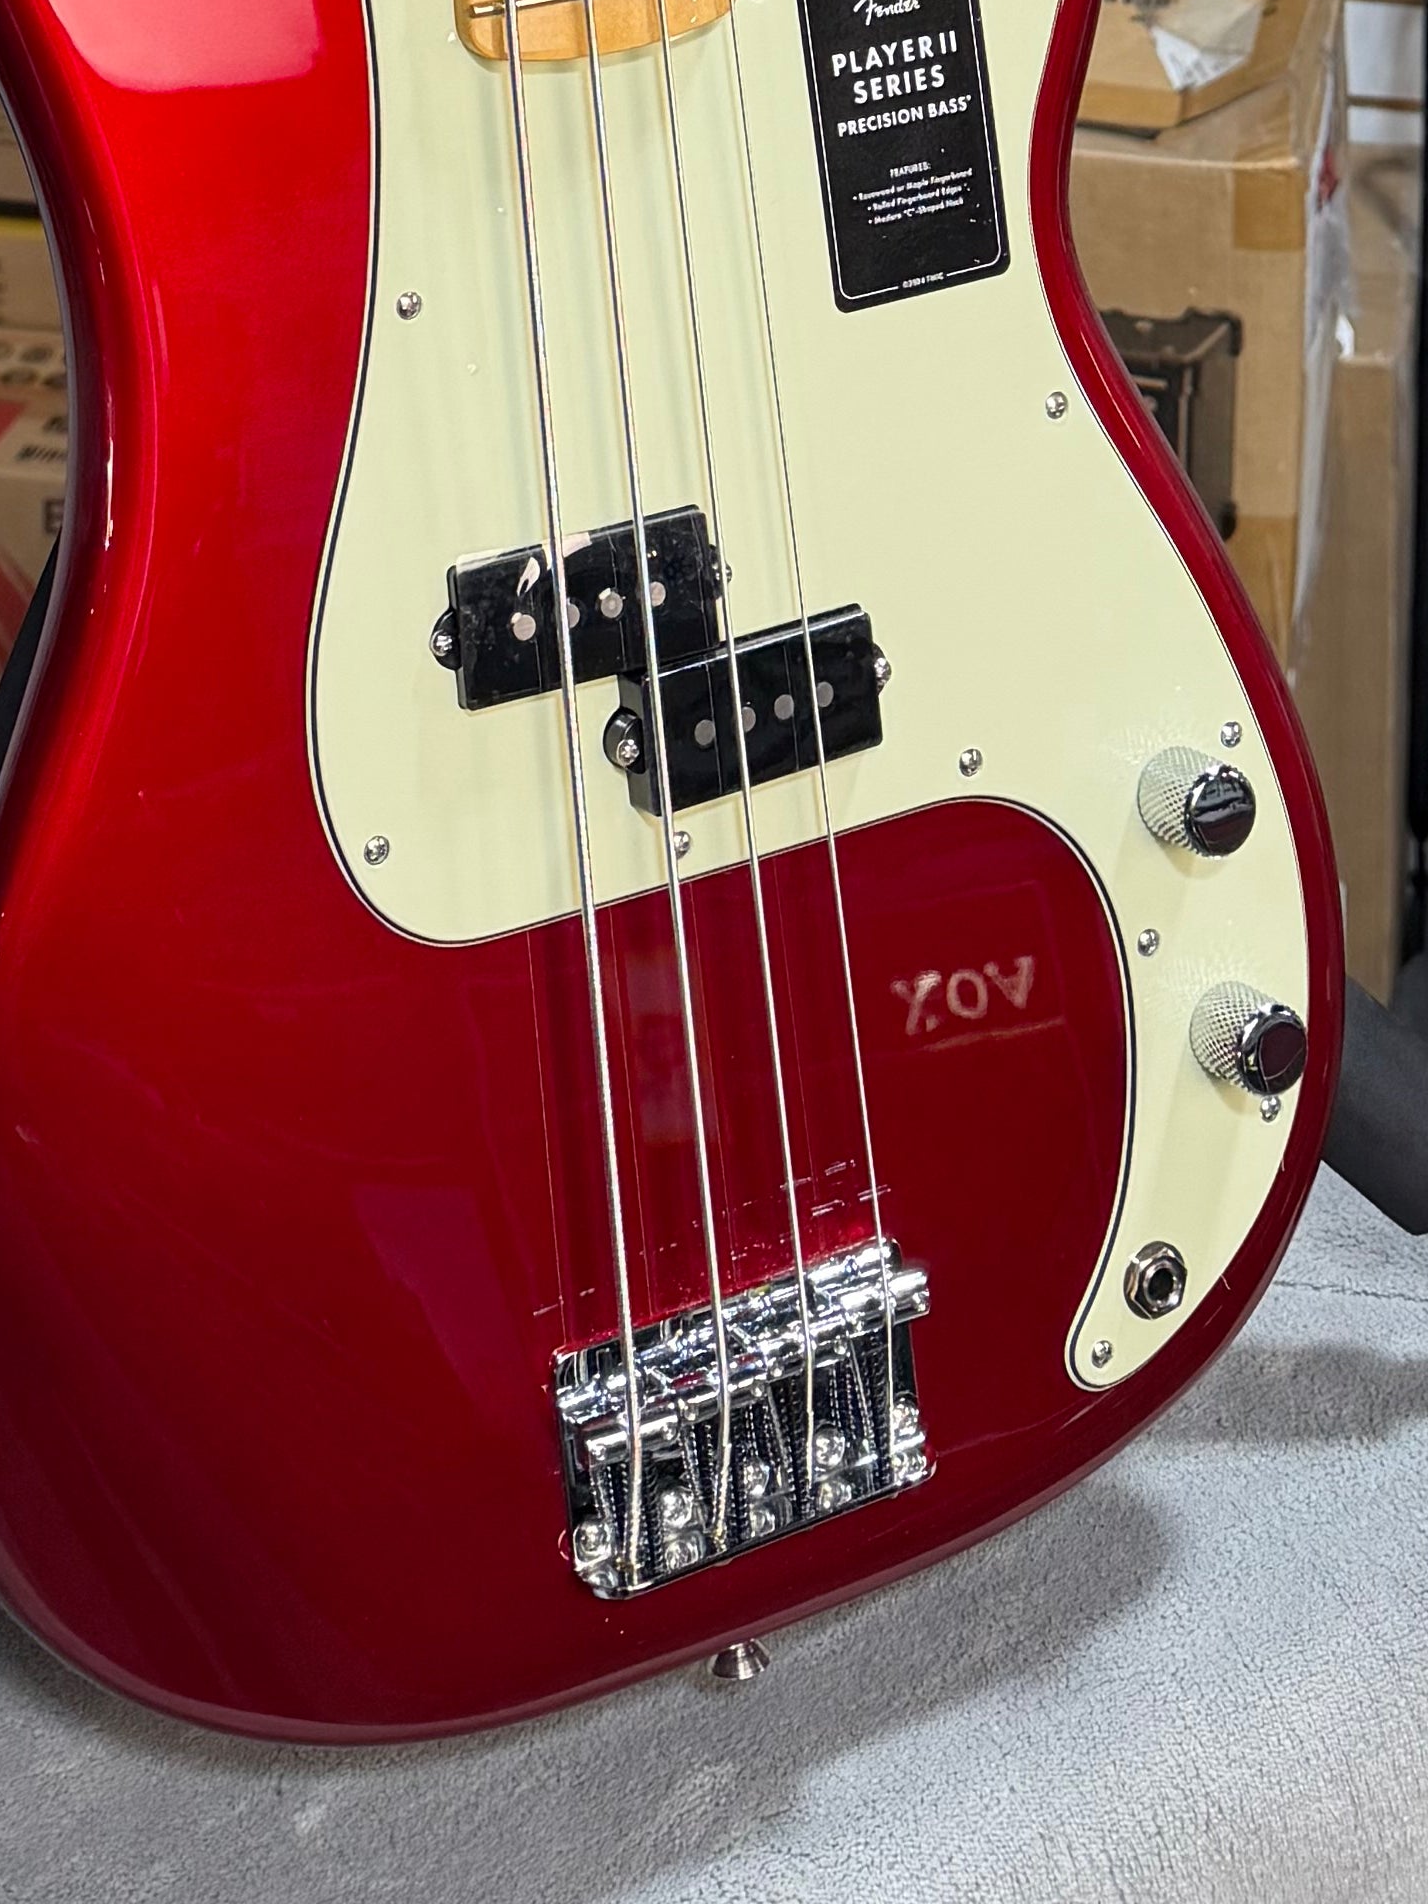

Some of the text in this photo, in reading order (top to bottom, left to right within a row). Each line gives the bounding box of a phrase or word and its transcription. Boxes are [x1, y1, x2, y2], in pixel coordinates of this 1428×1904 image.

[831, 30, 958, 77] PLAYER II
[853, 64, 945, 104] SERIES
[837, 106, 924, 137] PRECISION
[890, 161, 931, 178] FEATURES:
